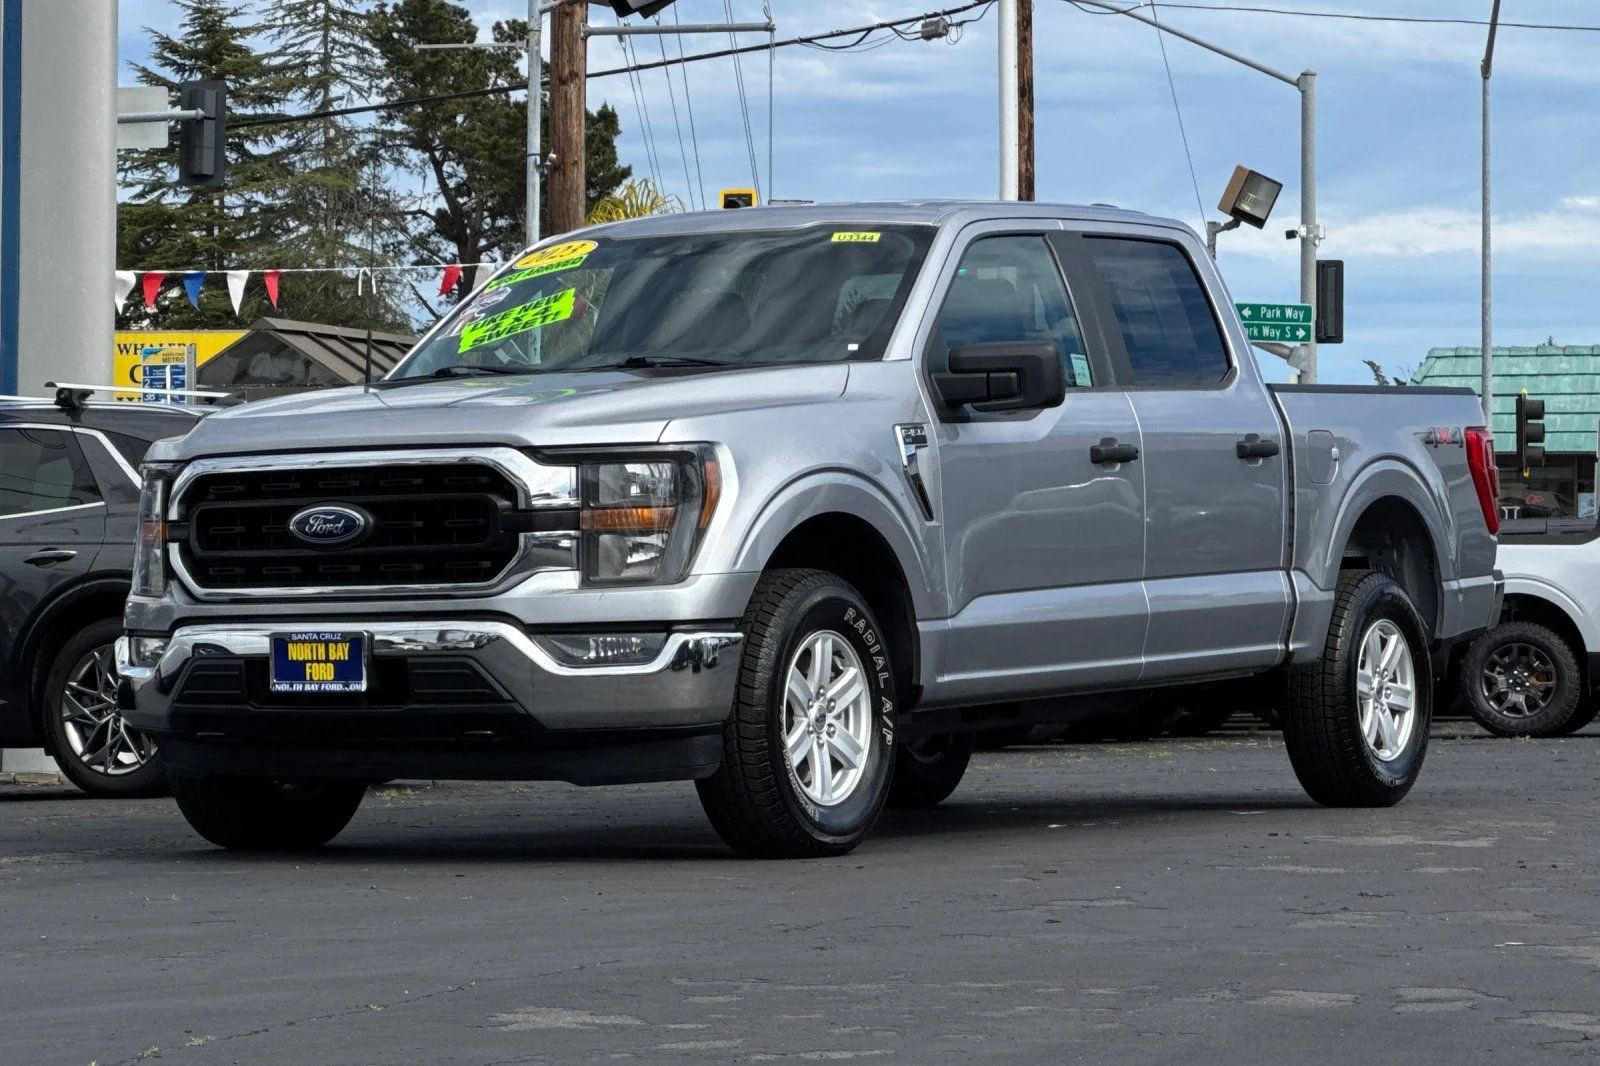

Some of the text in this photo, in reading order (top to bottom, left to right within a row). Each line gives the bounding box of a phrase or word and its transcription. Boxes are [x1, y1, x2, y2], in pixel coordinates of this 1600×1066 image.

[525, 256, 583, 277] ARRIVED
[469, 311, 511, 333] LIKE
[516, 292, 567, 315] NEW
[483, 321, 500, 333] 4
[531, 305, 551, 317] 4
[1260, 307, 1304, 322] Park Way
[469, 310, 562, 347] SWEET!
[1262, 325, 1280, 340] Way
[1285, 326, 1291, 338] S
[305, 514, 345, 534] Ford
[291, 633, 319, 641] SANTA
[288, 643, 350, 660] NORTH BAY
[305, 663, 335, 680] FORD
[844, 607, 893, 746] RADIAL A/P
[304, 683, 319, 691] BAY
